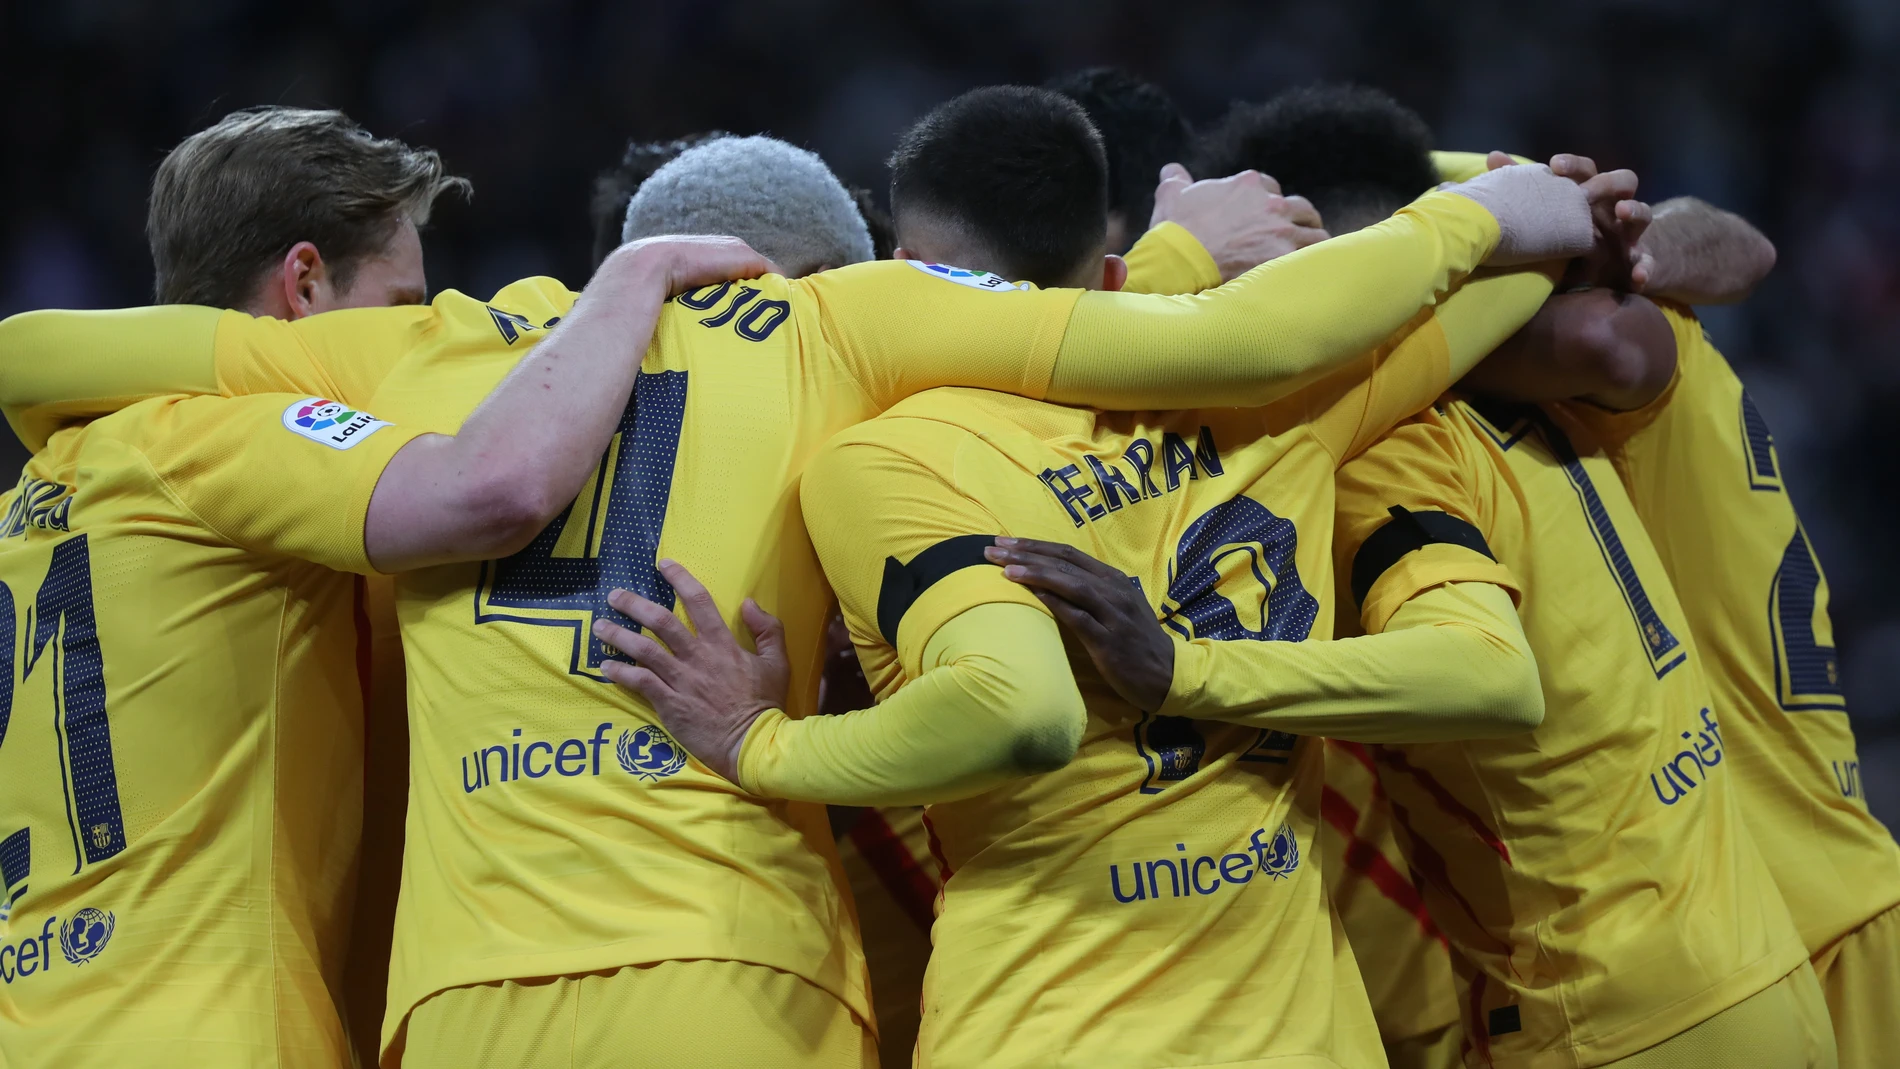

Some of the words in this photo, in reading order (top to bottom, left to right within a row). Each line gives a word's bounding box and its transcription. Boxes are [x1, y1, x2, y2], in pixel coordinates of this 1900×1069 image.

[475, 366, 688, 684] 4
[462, 722, 614, 794] unicef
[1110, 827, 1269, 904] unicef
[0, 916, 57, 985] cef
